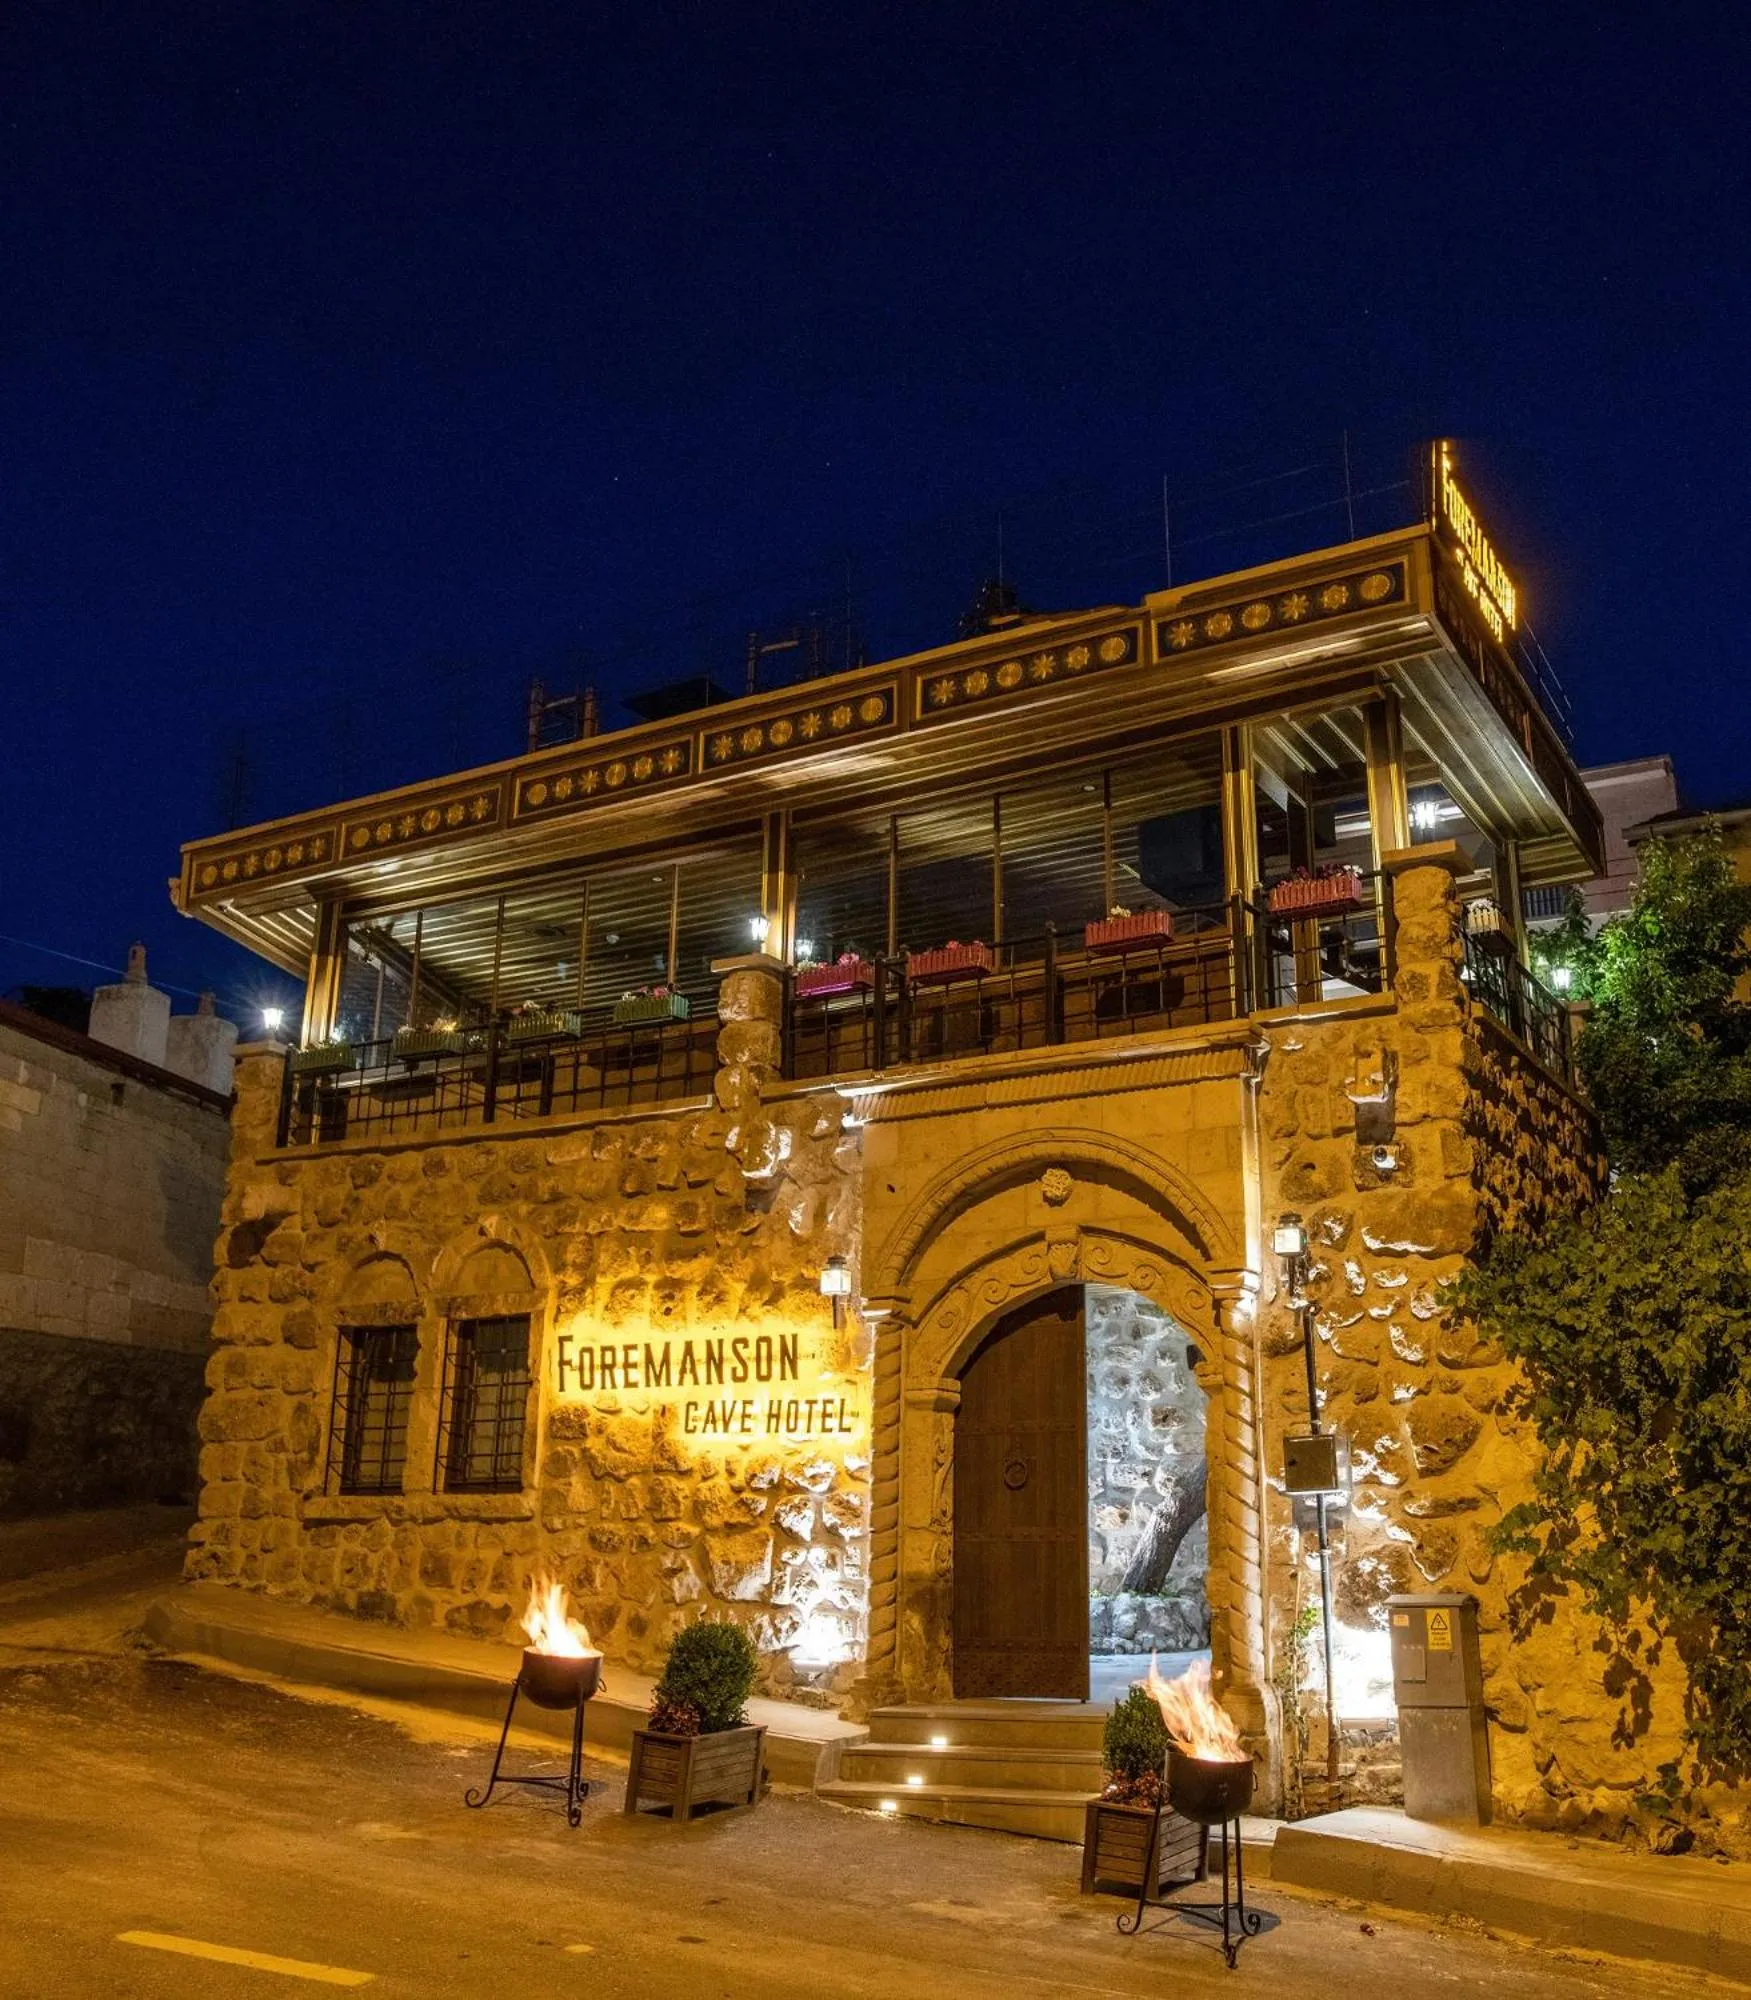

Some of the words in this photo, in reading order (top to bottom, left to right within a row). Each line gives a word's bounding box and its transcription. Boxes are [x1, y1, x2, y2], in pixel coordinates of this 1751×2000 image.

[558, 1333, 799, 1392] FOREMANSON
[684, 1399, 753, 1434] CAVE
[766, 1397, 852, 1434] HOTEL
